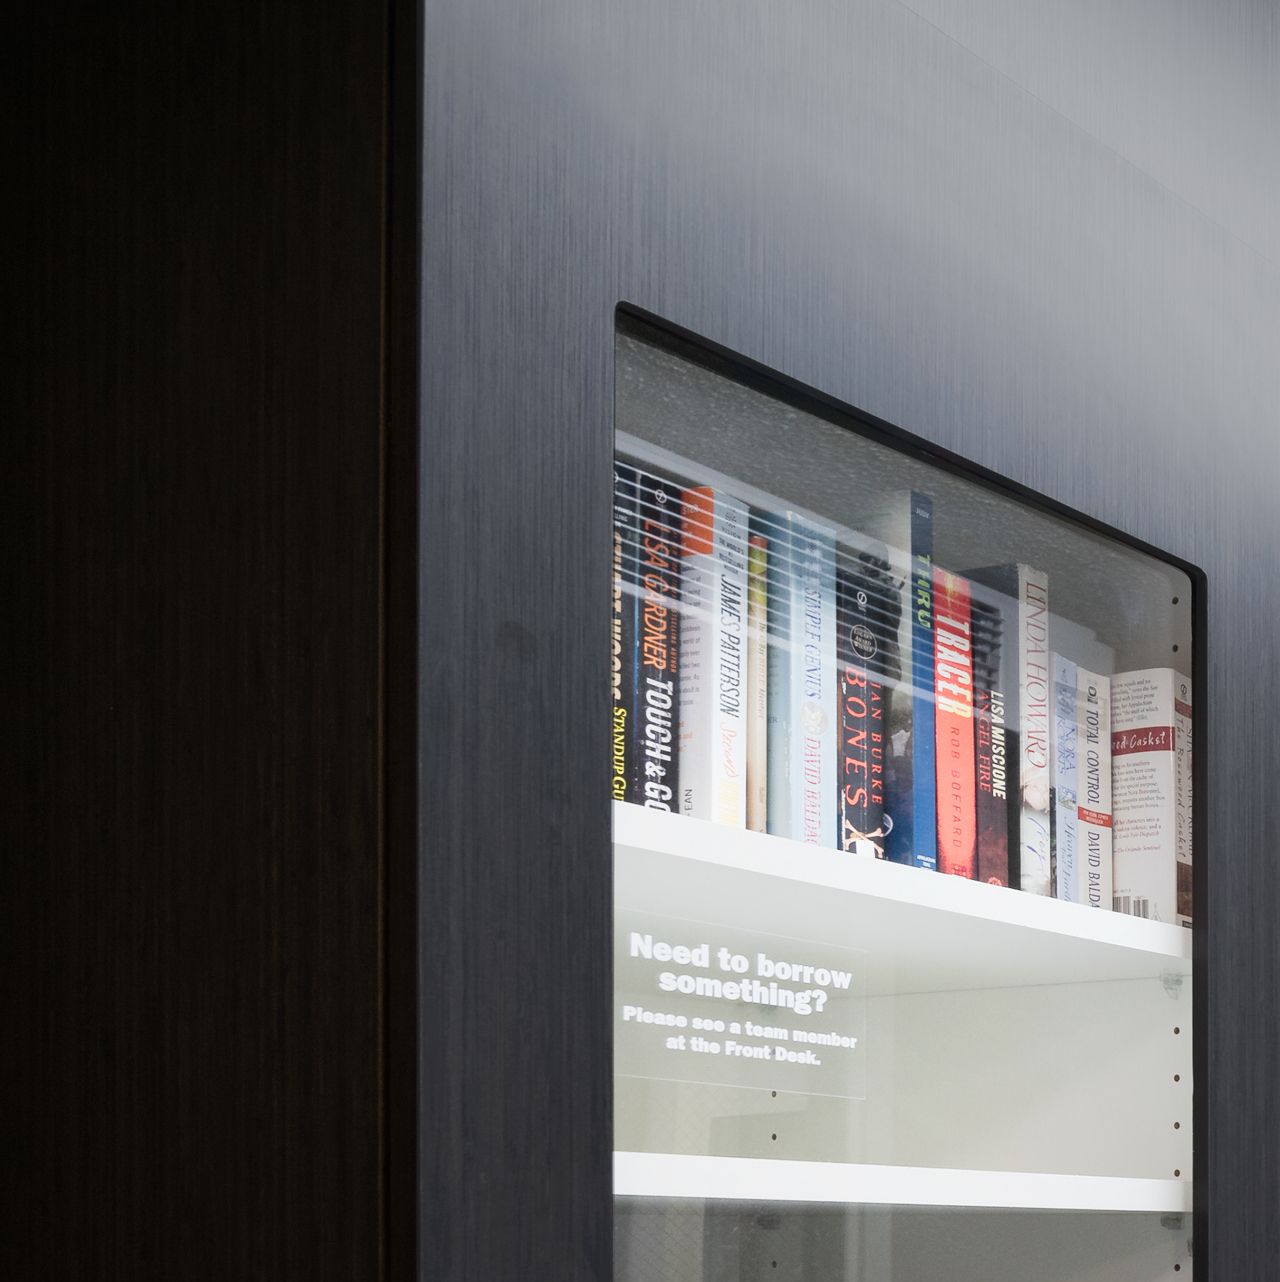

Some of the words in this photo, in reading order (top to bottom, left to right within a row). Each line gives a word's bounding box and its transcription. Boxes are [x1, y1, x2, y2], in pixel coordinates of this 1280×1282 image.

[643, 519, 669, 566] LISA
[643, 573, 669, 670] GARDNER
[720, 574, 742, 631] JAMES
[804, 586, 822, 642] SIMPLE
[1025, 581, 1047, 655] LINDA
[719, 629, 742, 719] PATTERSON
[804, 643, 822, 699] GENIUS
[936, 615, 971, 718] TRACER
[645, 677, 673, 760] TOUCH
[870, 682, 881, 720] JAN
[978, 690, 991, 749] ANGEL
[990, 690, 1005, 725] LISA
[1025, 661, 1047, 769] HOWARD
[1087, 709, 1099, 745] TOTAL
[804, 736, 822, 784] DAVID
[845, 667, 868, 808] BONES
[950, 727, 961, 754] ROB
[991, 726, 1006, 799] MISCIONE
[1130, 731, 1166, 750] Casket
[870, 732, 883, 805] BURKE
[979, 753, 992, 792] FIRE
[1087, 749, 1100, 804] CONTROL
[950, 769, 962, 848] BOFFARD
[1088, 830, 1100, 867] DAVID
[630, 932, 709, 968] Need
[717, 947, 749, 973] to
[757, 953, 852, 989] borrow
[659, 972, 827, 1015] something?
[623, 1005, 688, 1027] Please
[692, 1016, 725, 1032] see
[729, 1022, 741, 1034] a
[745, 1021, 788, 1040] team
[793, 1029, 857, 1048] member
[666, 1035, 686, 1050] at
[690, 1037, 721, 1054] the
[725, 1040, 771, 1060] Front
[775, 1046, 821, 1065] Desk.
